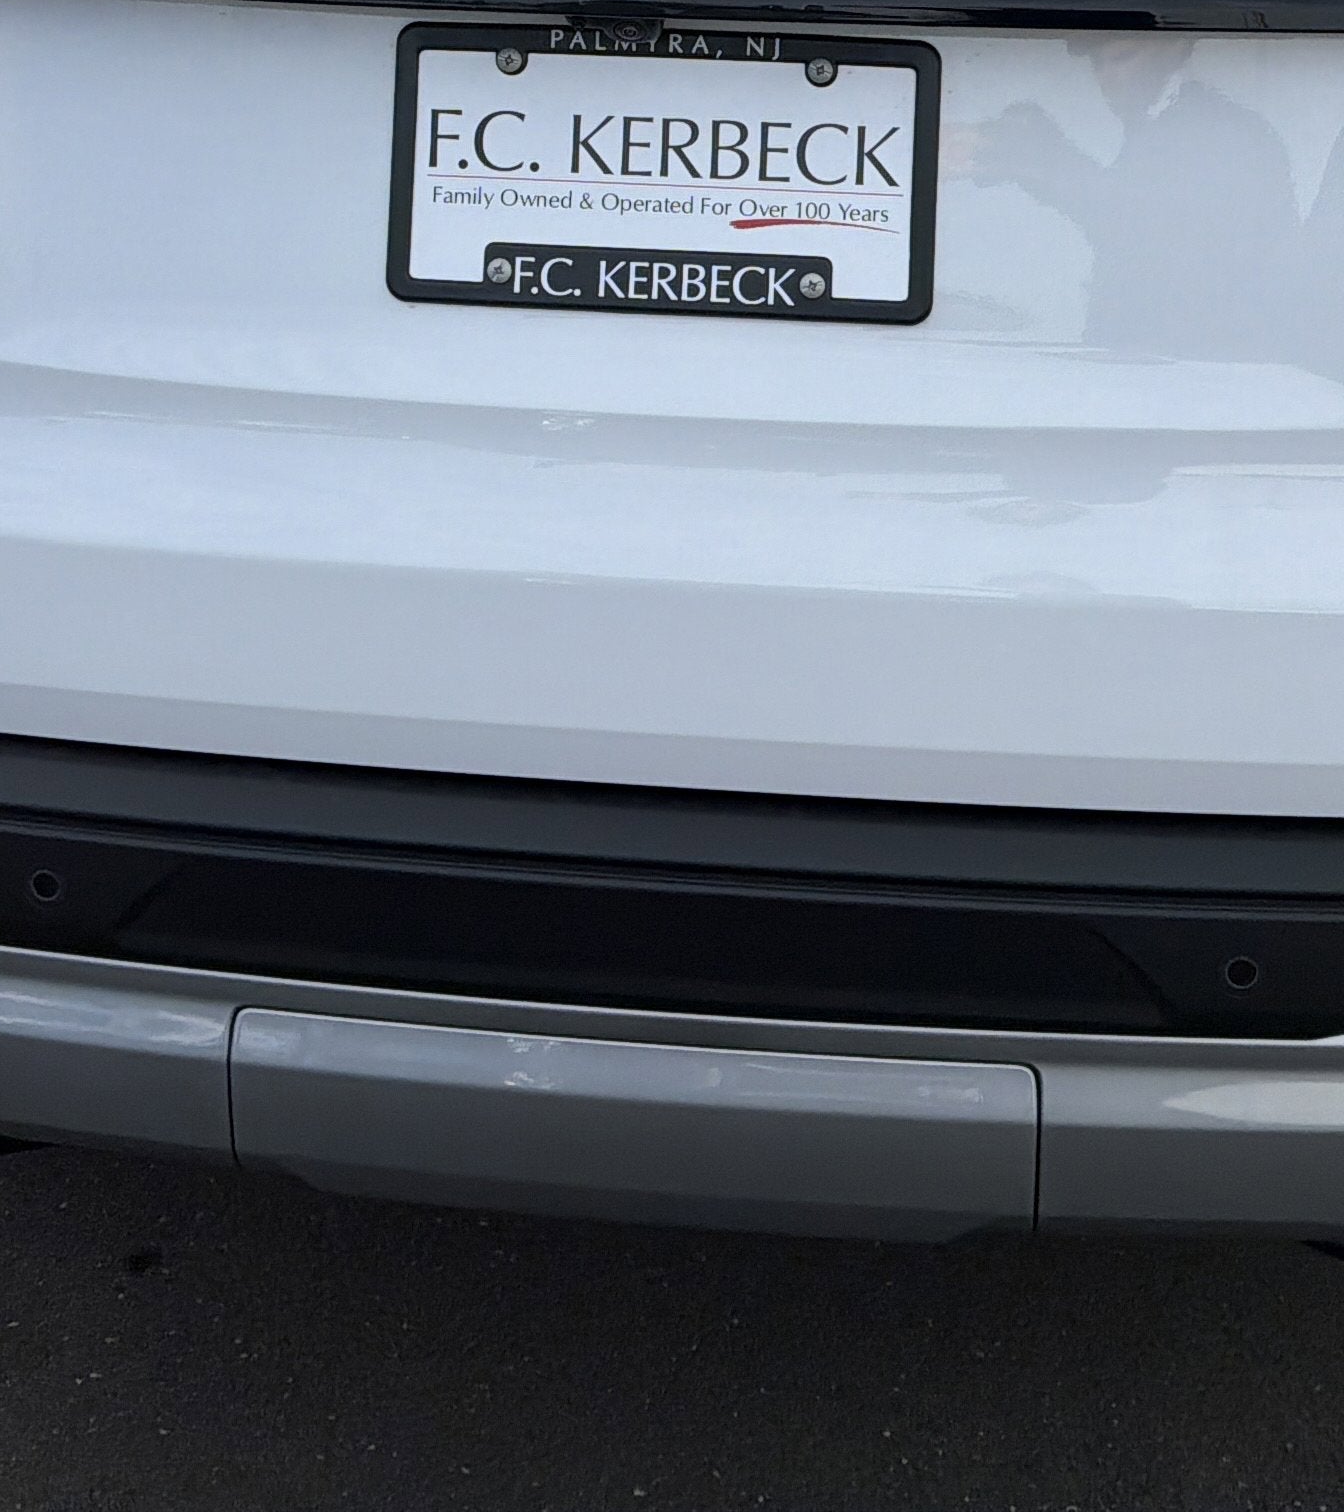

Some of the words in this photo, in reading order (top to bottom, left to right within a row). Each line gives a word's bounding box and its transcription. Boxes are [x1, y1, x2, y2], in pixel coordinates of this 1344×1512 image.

[746, 36, 781, 60] NJ
[428, 108, 540, 172] F.C.
[570, 114, 901, 187] KERBECK
[432, 186, 495, 209] Family
[500, 188, 573, 209] Owned
[579, 192, 593, 209] &
[601, 192, 694, 215] Operated
[700, 197, 733, 215] For
[739, 198, 788, 218] Over
[796, 201, 831, 219] 100
[838, 202, 889, 223] Years
[513, 256, 582, 297] F.C.
[598, 259, 796, 306] KERBECK
